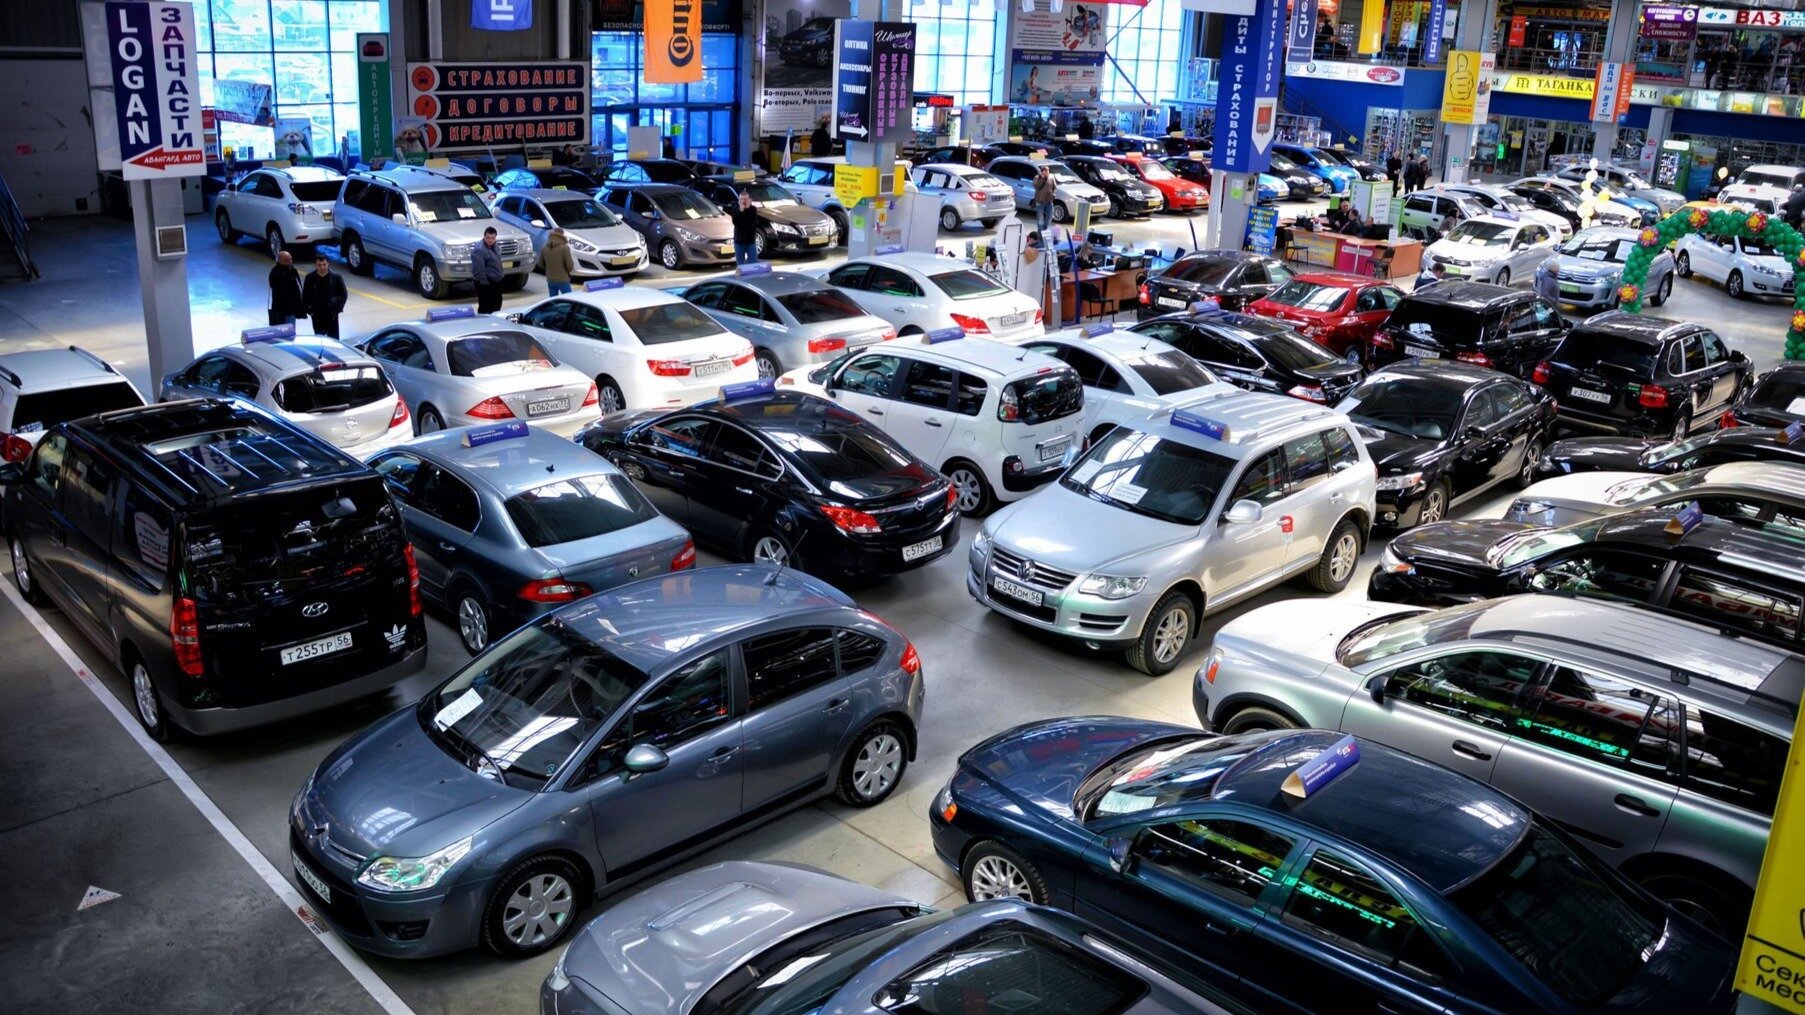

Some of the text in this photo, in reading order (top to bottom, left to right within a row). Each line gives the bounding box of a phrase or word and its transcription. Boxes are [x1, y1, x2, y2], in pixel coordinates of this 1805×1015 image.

[1736, 11, 1781, 26] ВАЗ
[1651, 29, 1687, 37] СЛОЖНОСТИ
[844, 40, 868, 50] ОПТИКА
[840, 62, 872, 73] АКСЕССУАРЫ
[118, 9, 150, 145] LOGAN
[160, 7, 193, 148] ЗАПЧАСТИ
[447, 69, 577, 86] СТРАХОВАНИЕ
[842, 84, 867, 95] ТЮНИНГ
[1536, 79, 1593, 92] ТАГАНКА
[370, 64, 381, 156] АВТОКРЕДИТЫ
[448, 96, 577, 117] ДОГОВОРЫ
[1226, 64, 1244, 165] СТРАХОВАНИЕ
[450, 121, 576, 142] КРЕДИТОВАНИЕ
[143, 154, 201, 164] АВАНГАРД АВТО
[532, 402, 558, 413] А062НХ
[905, 541, 932, 557] С575ТТ
[997, 581, 1040, 601] С543ОМ 56
[286, 634, 349, 662] Т255ТР 56
